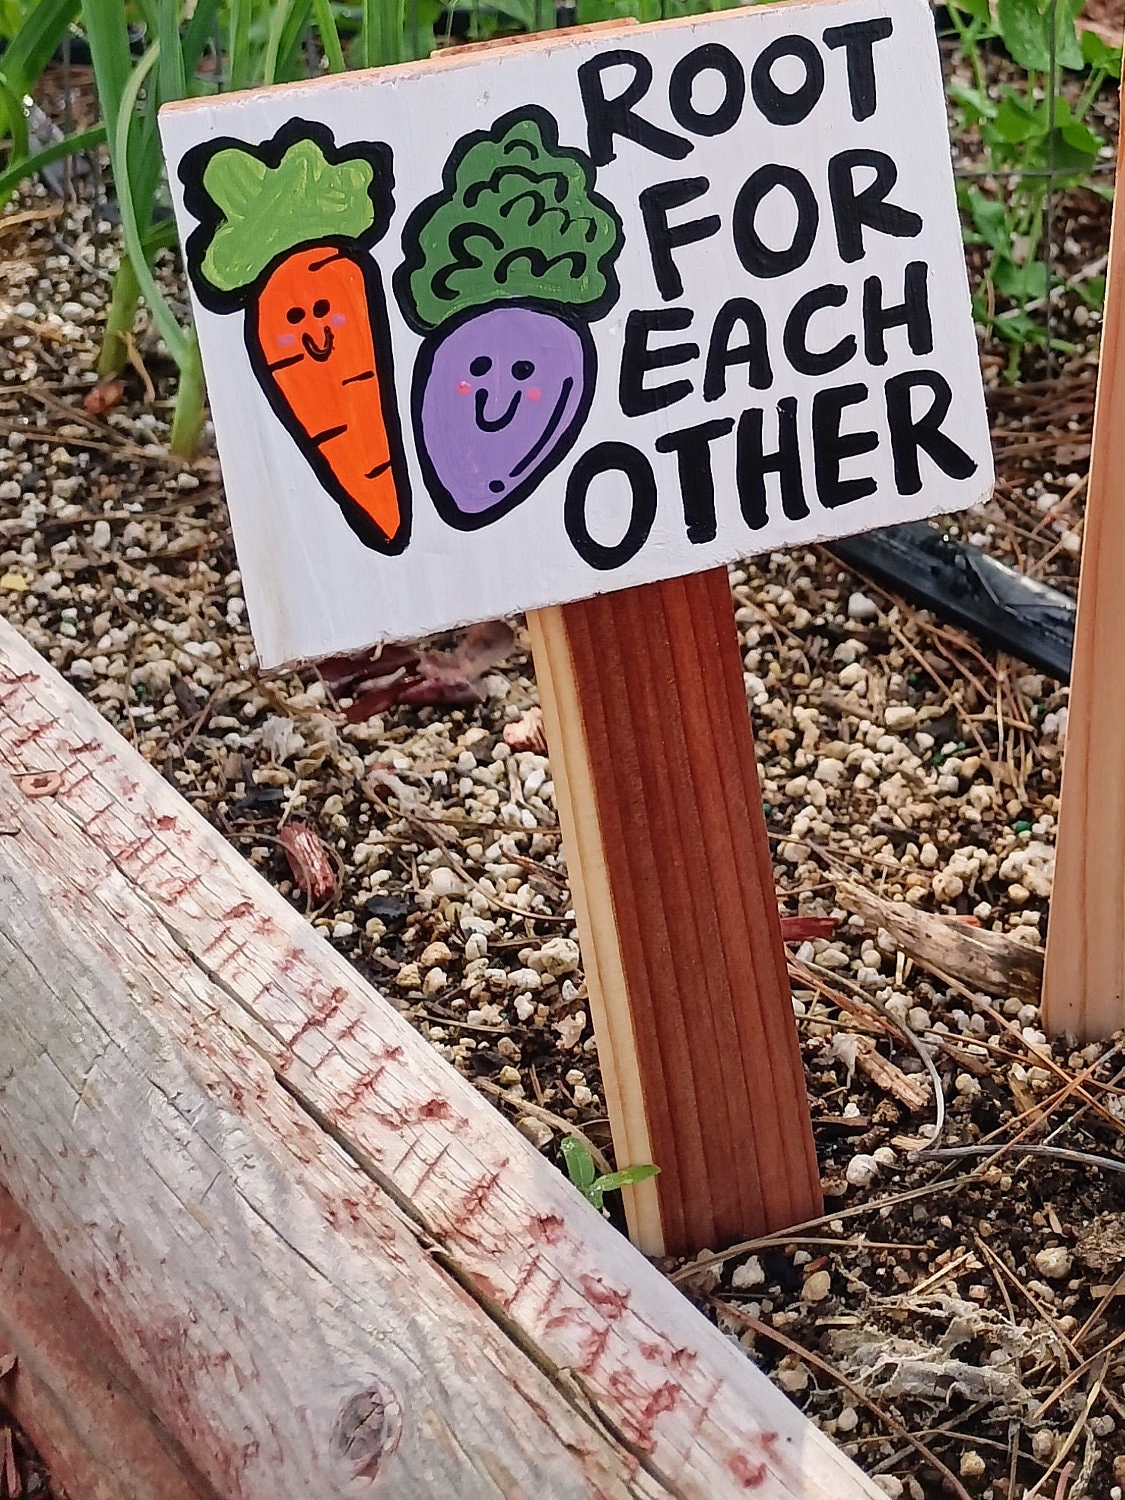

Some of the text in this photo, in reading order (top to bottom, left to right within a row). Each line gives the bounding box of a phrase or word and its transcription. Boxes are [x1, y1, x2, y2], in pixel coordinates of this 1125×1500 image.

[577, 17, 892, 166] ROOT
[639, 149, 923, 301] FOR
[618, 260, 933, 417] EACH
[564, 369, 978, 570] OTHER
